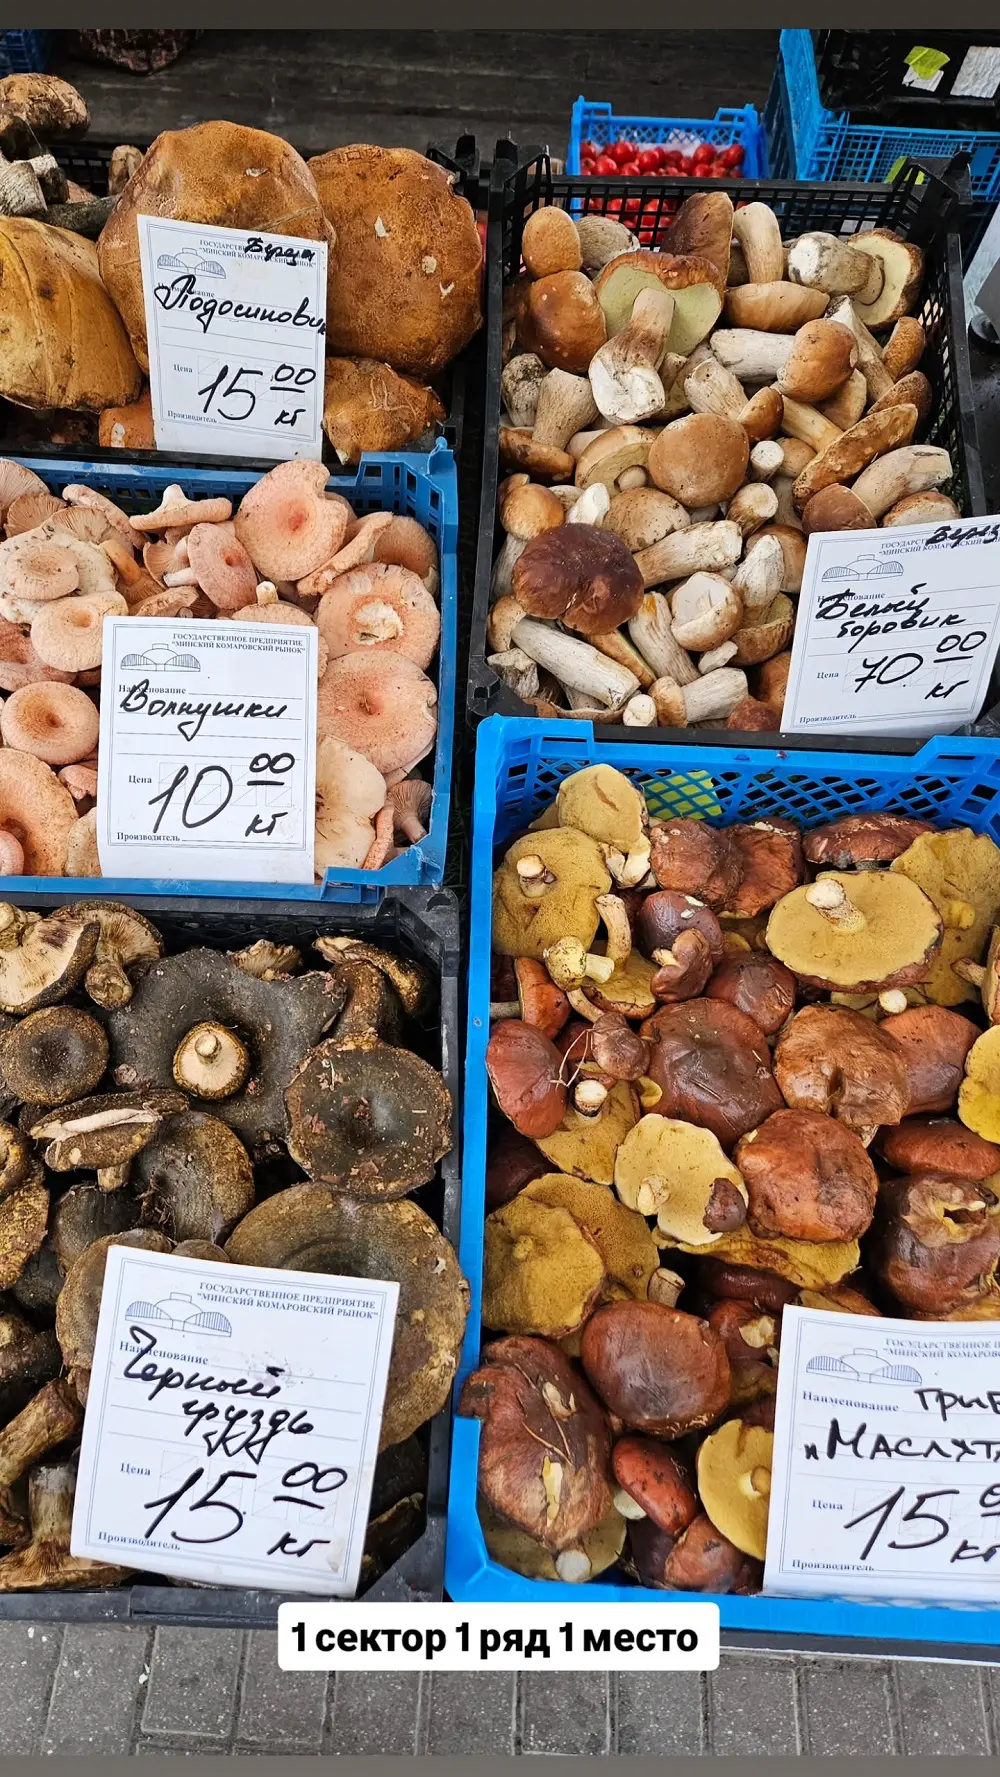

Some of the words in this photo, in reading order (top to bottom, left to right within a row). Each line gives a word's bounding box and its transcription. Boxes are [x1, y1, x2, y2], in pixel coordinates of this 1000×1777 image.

[237, 252, 288, 264] КОМАРОСКИЙ
[173, 364, 193, 373] Цена
[198, 365, 263, 420] 15
[274, 363, 316, 385] 00
[167, 410, 217, 423] Производитель
[274, 409, 306, 426] кг
[922, 540, 981, 551] КОМАРОСКИЙ
[815, 583, 930, 619] Белый
[817, 593, 885, 602] Ненование
[173, 633, 247, 642] ГОСУДАРСТВЕННОЕ
[248, 637, 303, 646] ПРЕДПРИЯТИЕ
[837, 609, 966, 653] боровик
[215, 642, 273, 652] КОМАРОВСКИЙ
[816, 671, 839, 679] Цена
[936, 631, 987, 653] 00
[924, 679, 969, 700] кг
[120, 678, 288, 742] Волнушки
[800, 714, 857, 724] Производитель
[128, 775, 152, 785] Цена
[148, 765, 233, 833] 10
[249, 753, 295, 773] 00
[245, 812, 288, 837] кг
[117, 831, 181, 842] Производитель
[199, 1282, 300, 1301] ГОСУДАРСТВЕННОЕ
[302, 1294, 376, 1309] ПРЕДПРИЯТИЕ
[256, 1300, 334, 1315] КОМАРОВСКИЙ
[885, 1338, 991, 1349] ГОСУДАРСТВЕННОЕ
[946, 1350, 1000, 1358] КОМАРОВ
[803, 1390, 900, 1412] Наименование
[120, 1462, 151, 1476] Цена
[144, 1467, 257, 1543] 15
[281, 1461, 348, 1492] 00
[812, 1499, 843, 1511] Цена
[843, 1485, 960, 1560] 15
[98, 1531, 181, 1550] Производитель
[267, 1532, 331, 1557] кг
[791, 1558, 875, 1572] Производитель
